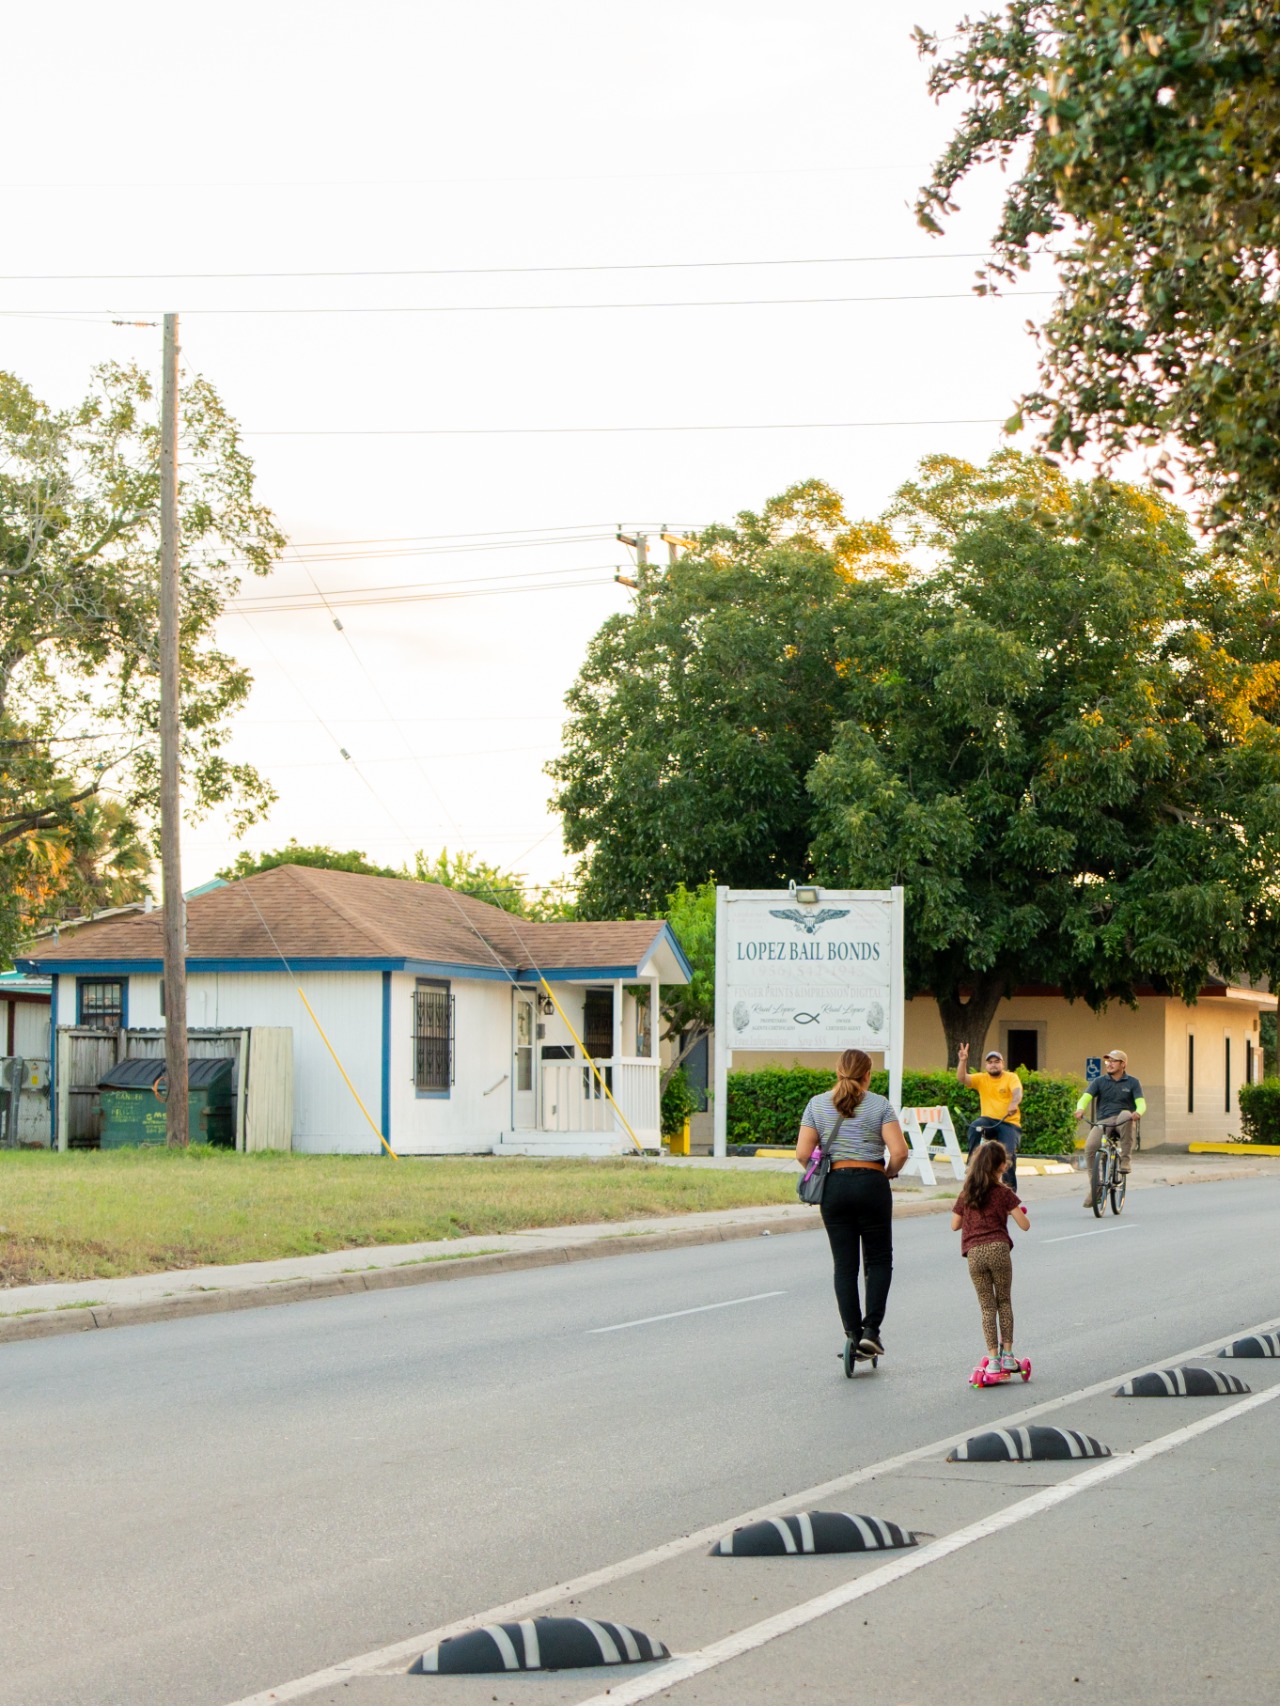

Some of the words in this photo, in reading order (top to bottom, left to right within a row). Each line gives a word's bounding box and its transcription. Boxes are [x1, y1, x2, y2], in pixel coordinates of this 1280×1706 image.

[737, 942, 786, 961] LOPEZ
[789, 942, 824, 961] BAIL
[827, 942, 880, 961] BONDS
[734, 987, 763, 998] FINGER
[765, 987, 794, 998] PRINTS
[800, 987, 848, 998] IMPRESSION
[850, 987, 881, 998] DIGITAL
